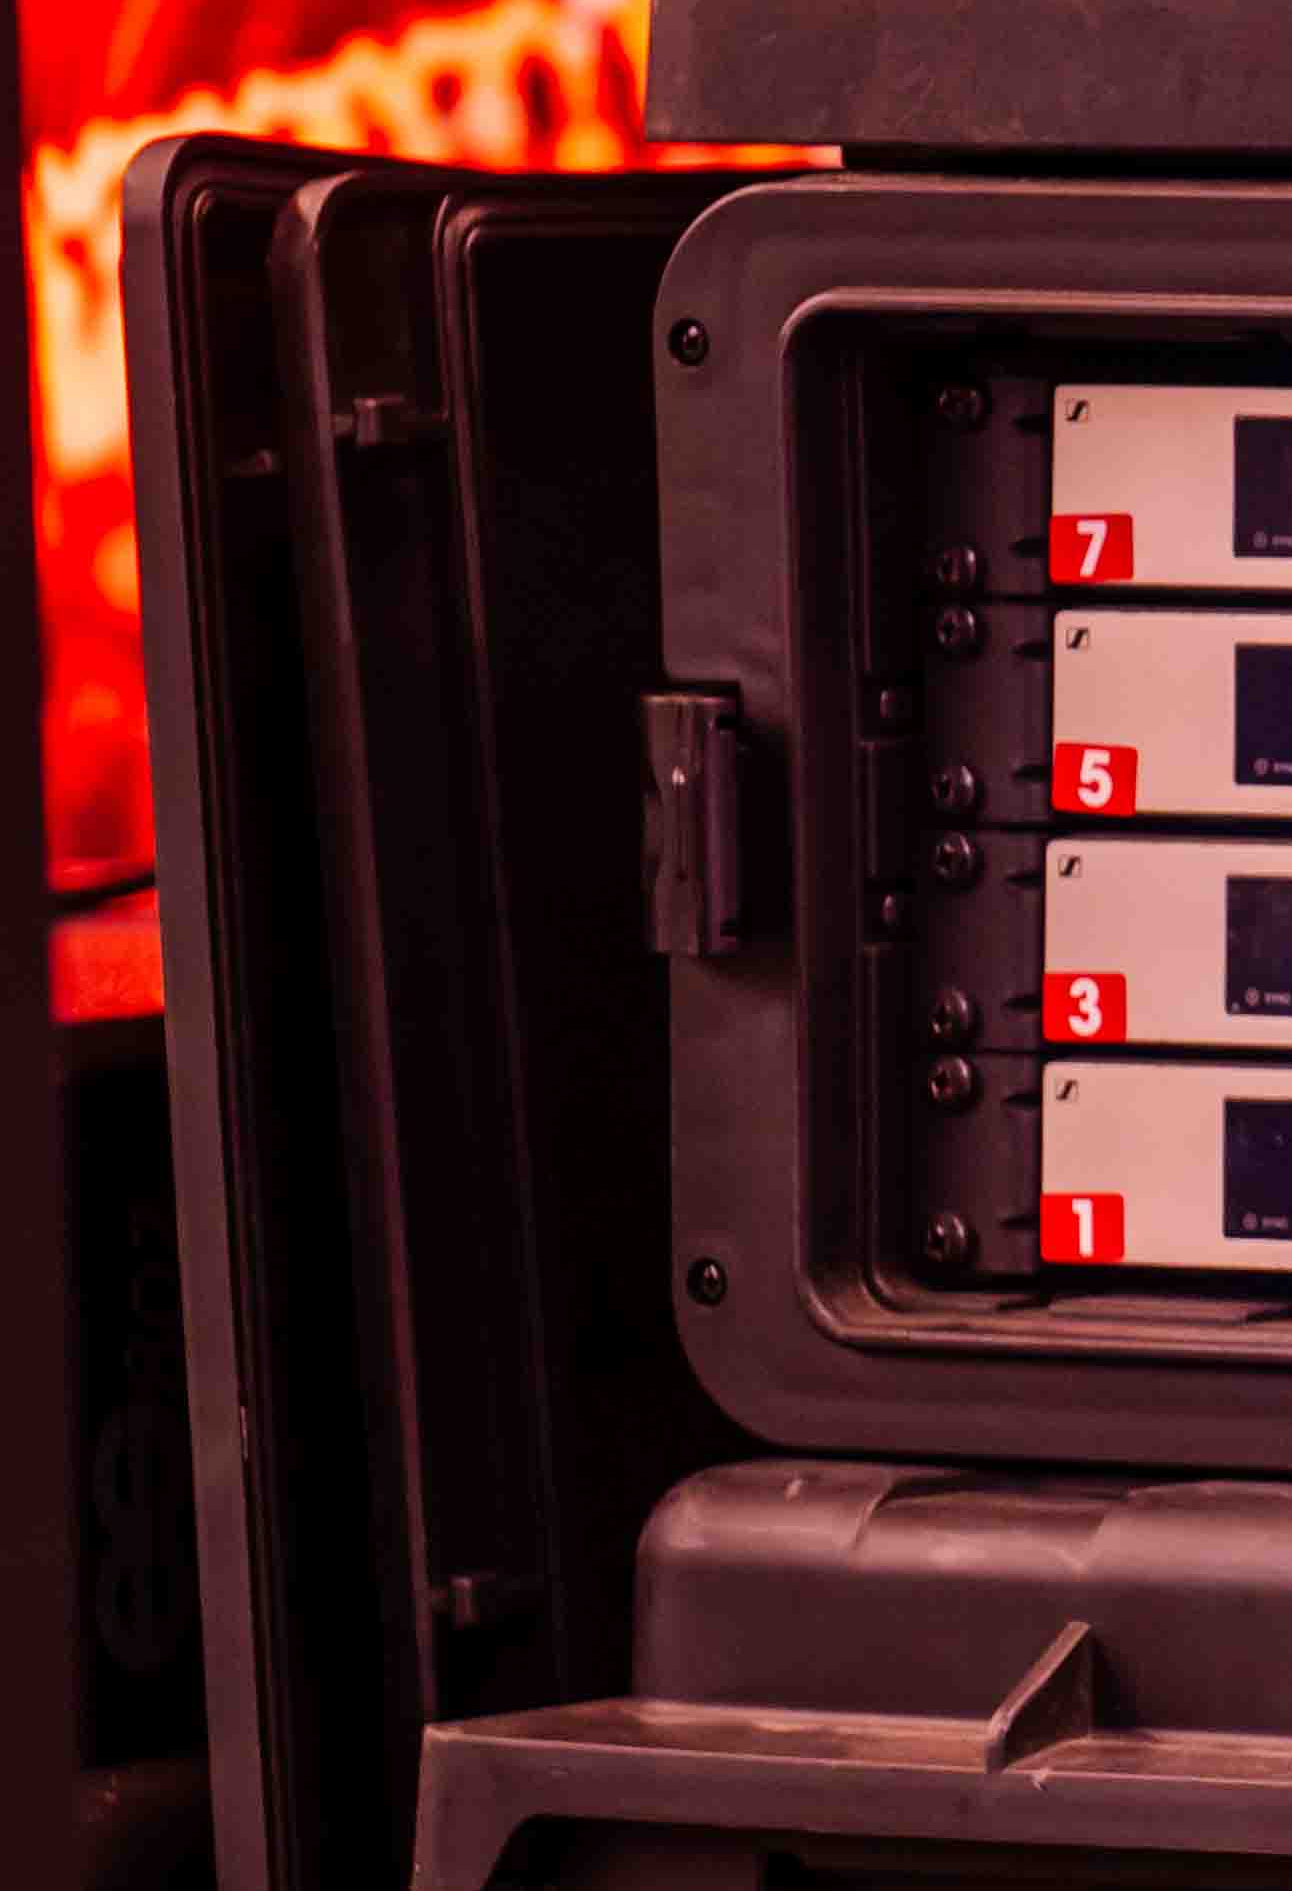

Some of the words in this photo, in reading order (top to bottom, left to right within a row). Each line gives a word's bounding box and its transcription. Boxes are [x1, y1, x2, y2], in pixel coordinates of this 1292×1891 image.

[1077, 520, 1107, 577] 7
[1078, 749, 1112, 807] 5
[1069, 978, 1101, 1036] 3
[1072, 1199, 1093, 1256] 1
